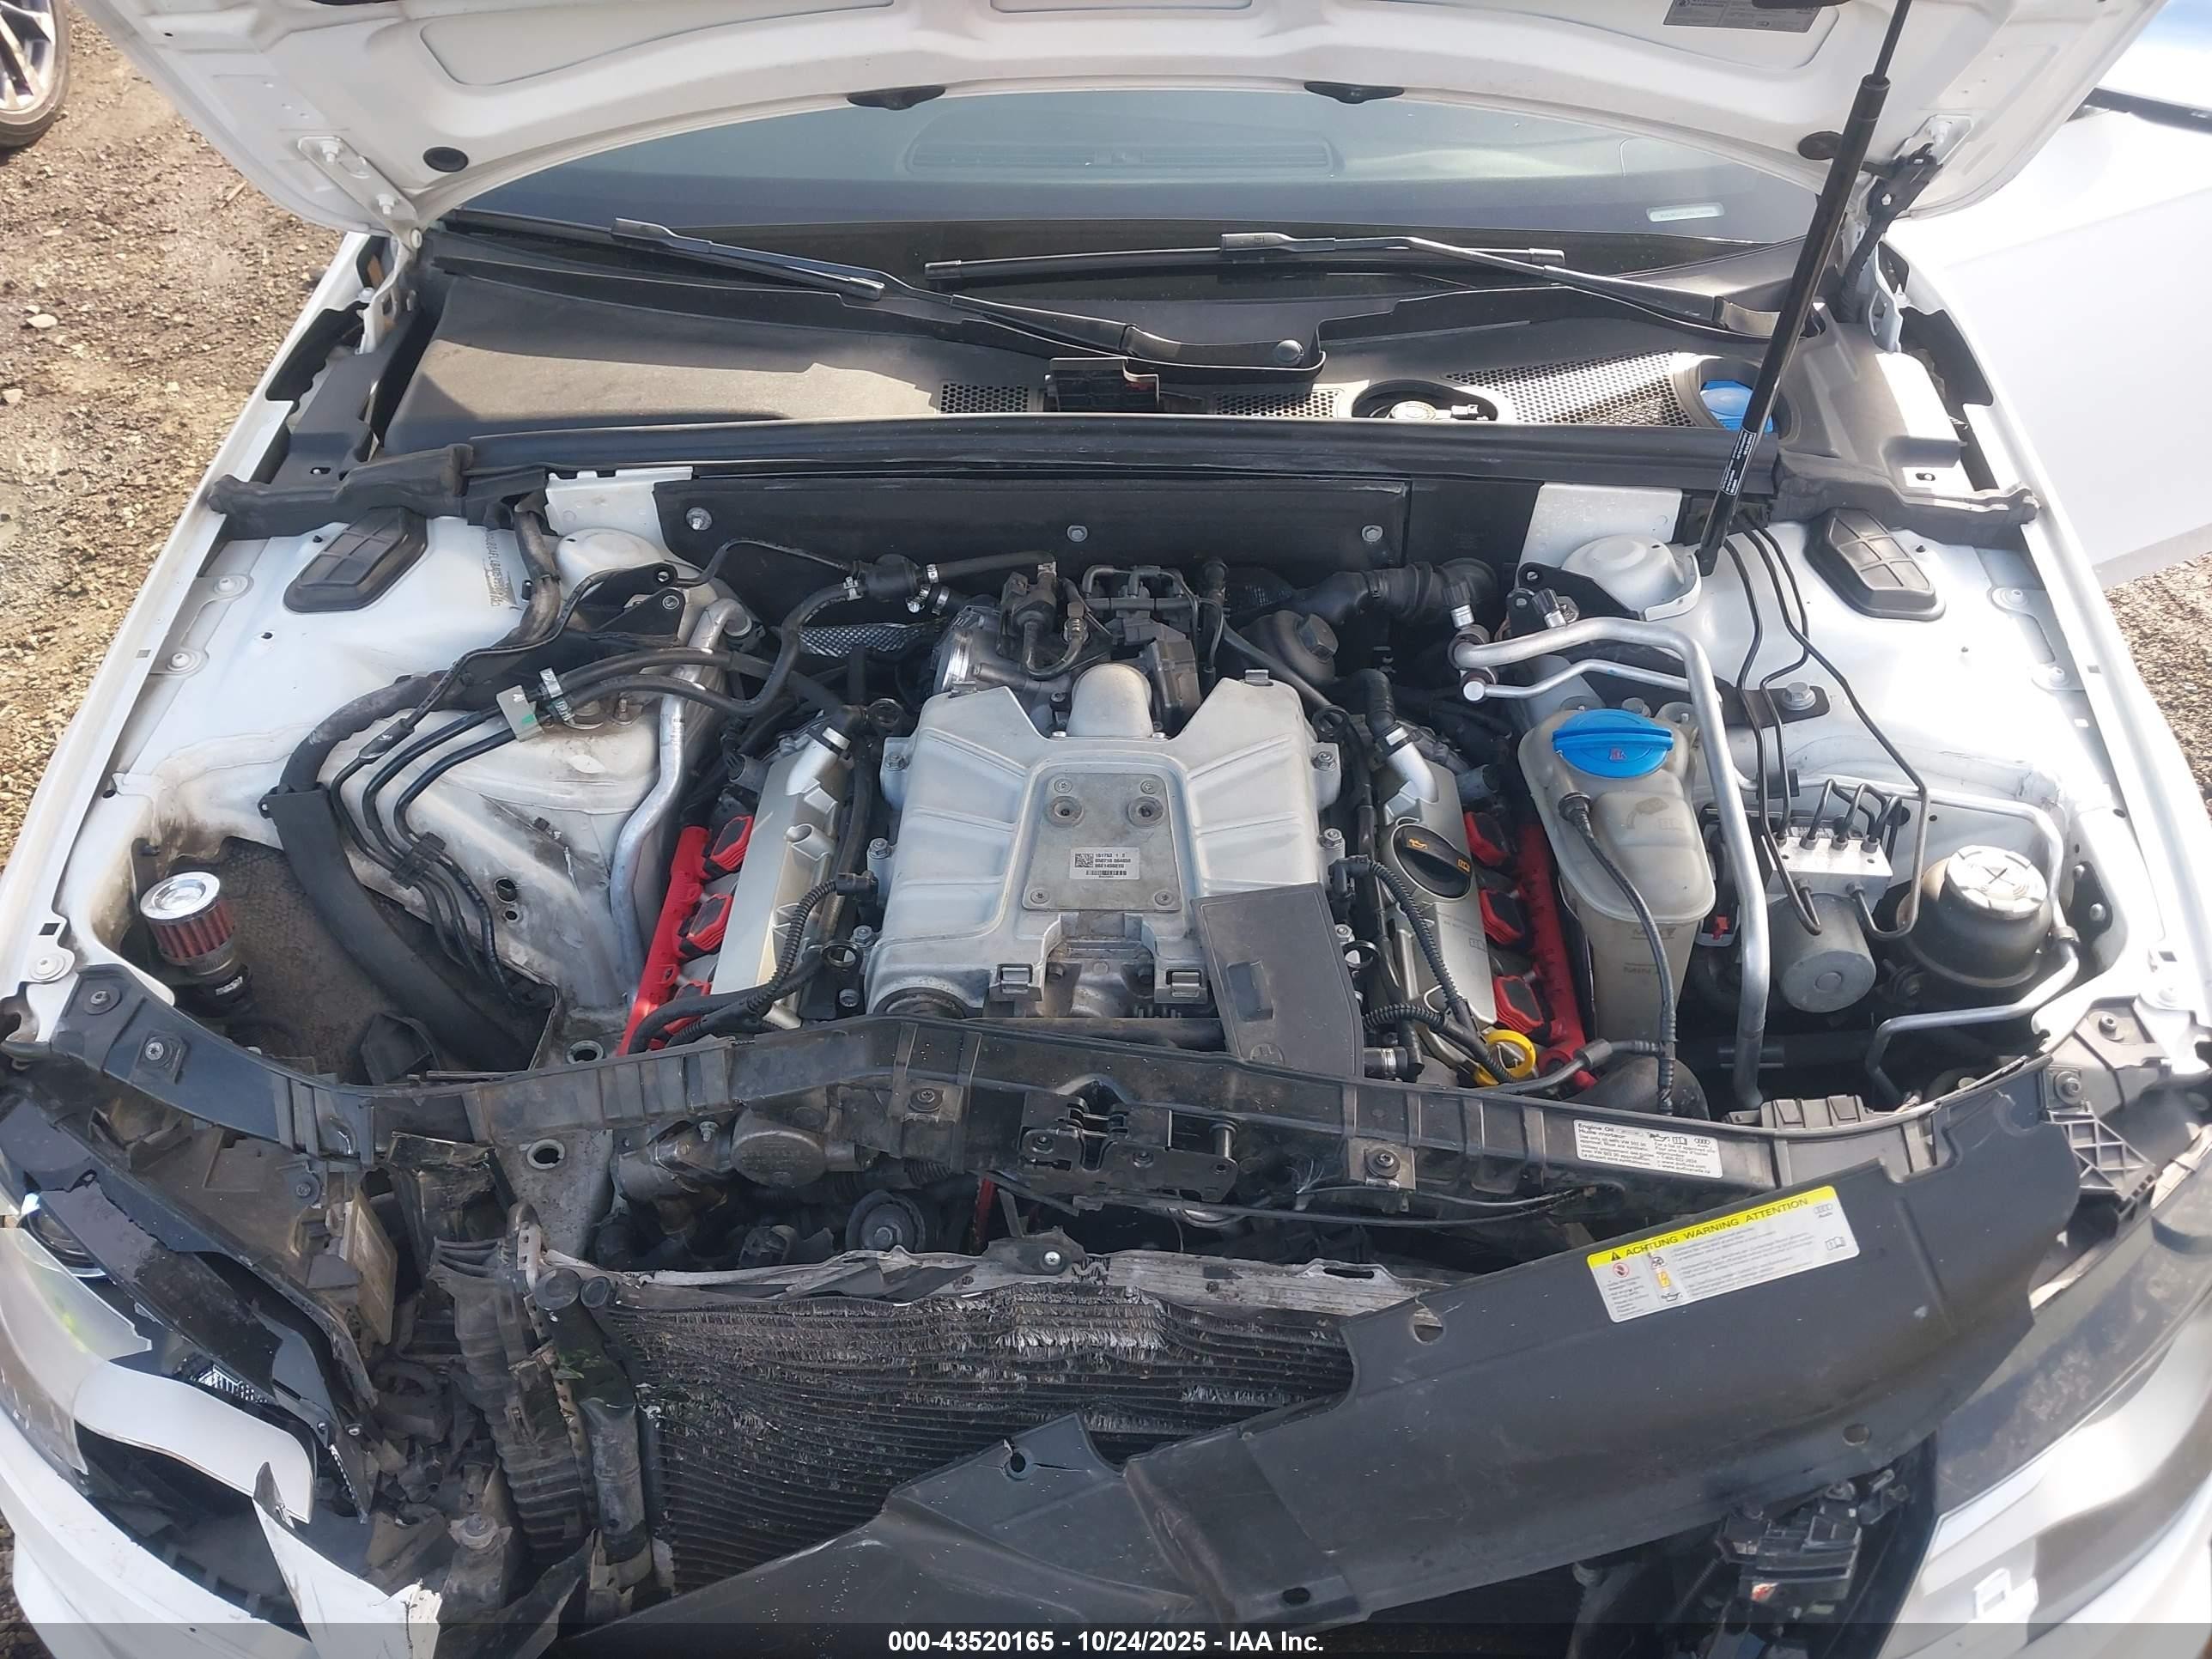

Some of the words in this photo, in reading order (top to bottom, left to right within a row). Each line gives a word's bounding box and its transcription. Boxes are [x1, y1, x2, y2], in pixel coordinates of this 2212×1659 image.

[1626, 1236, 1678, 1257] ACHTUNG
[1683, 1218, 1739, 1240] WARNING
[1746, 1197, 1808, 1222] ATTENTION
